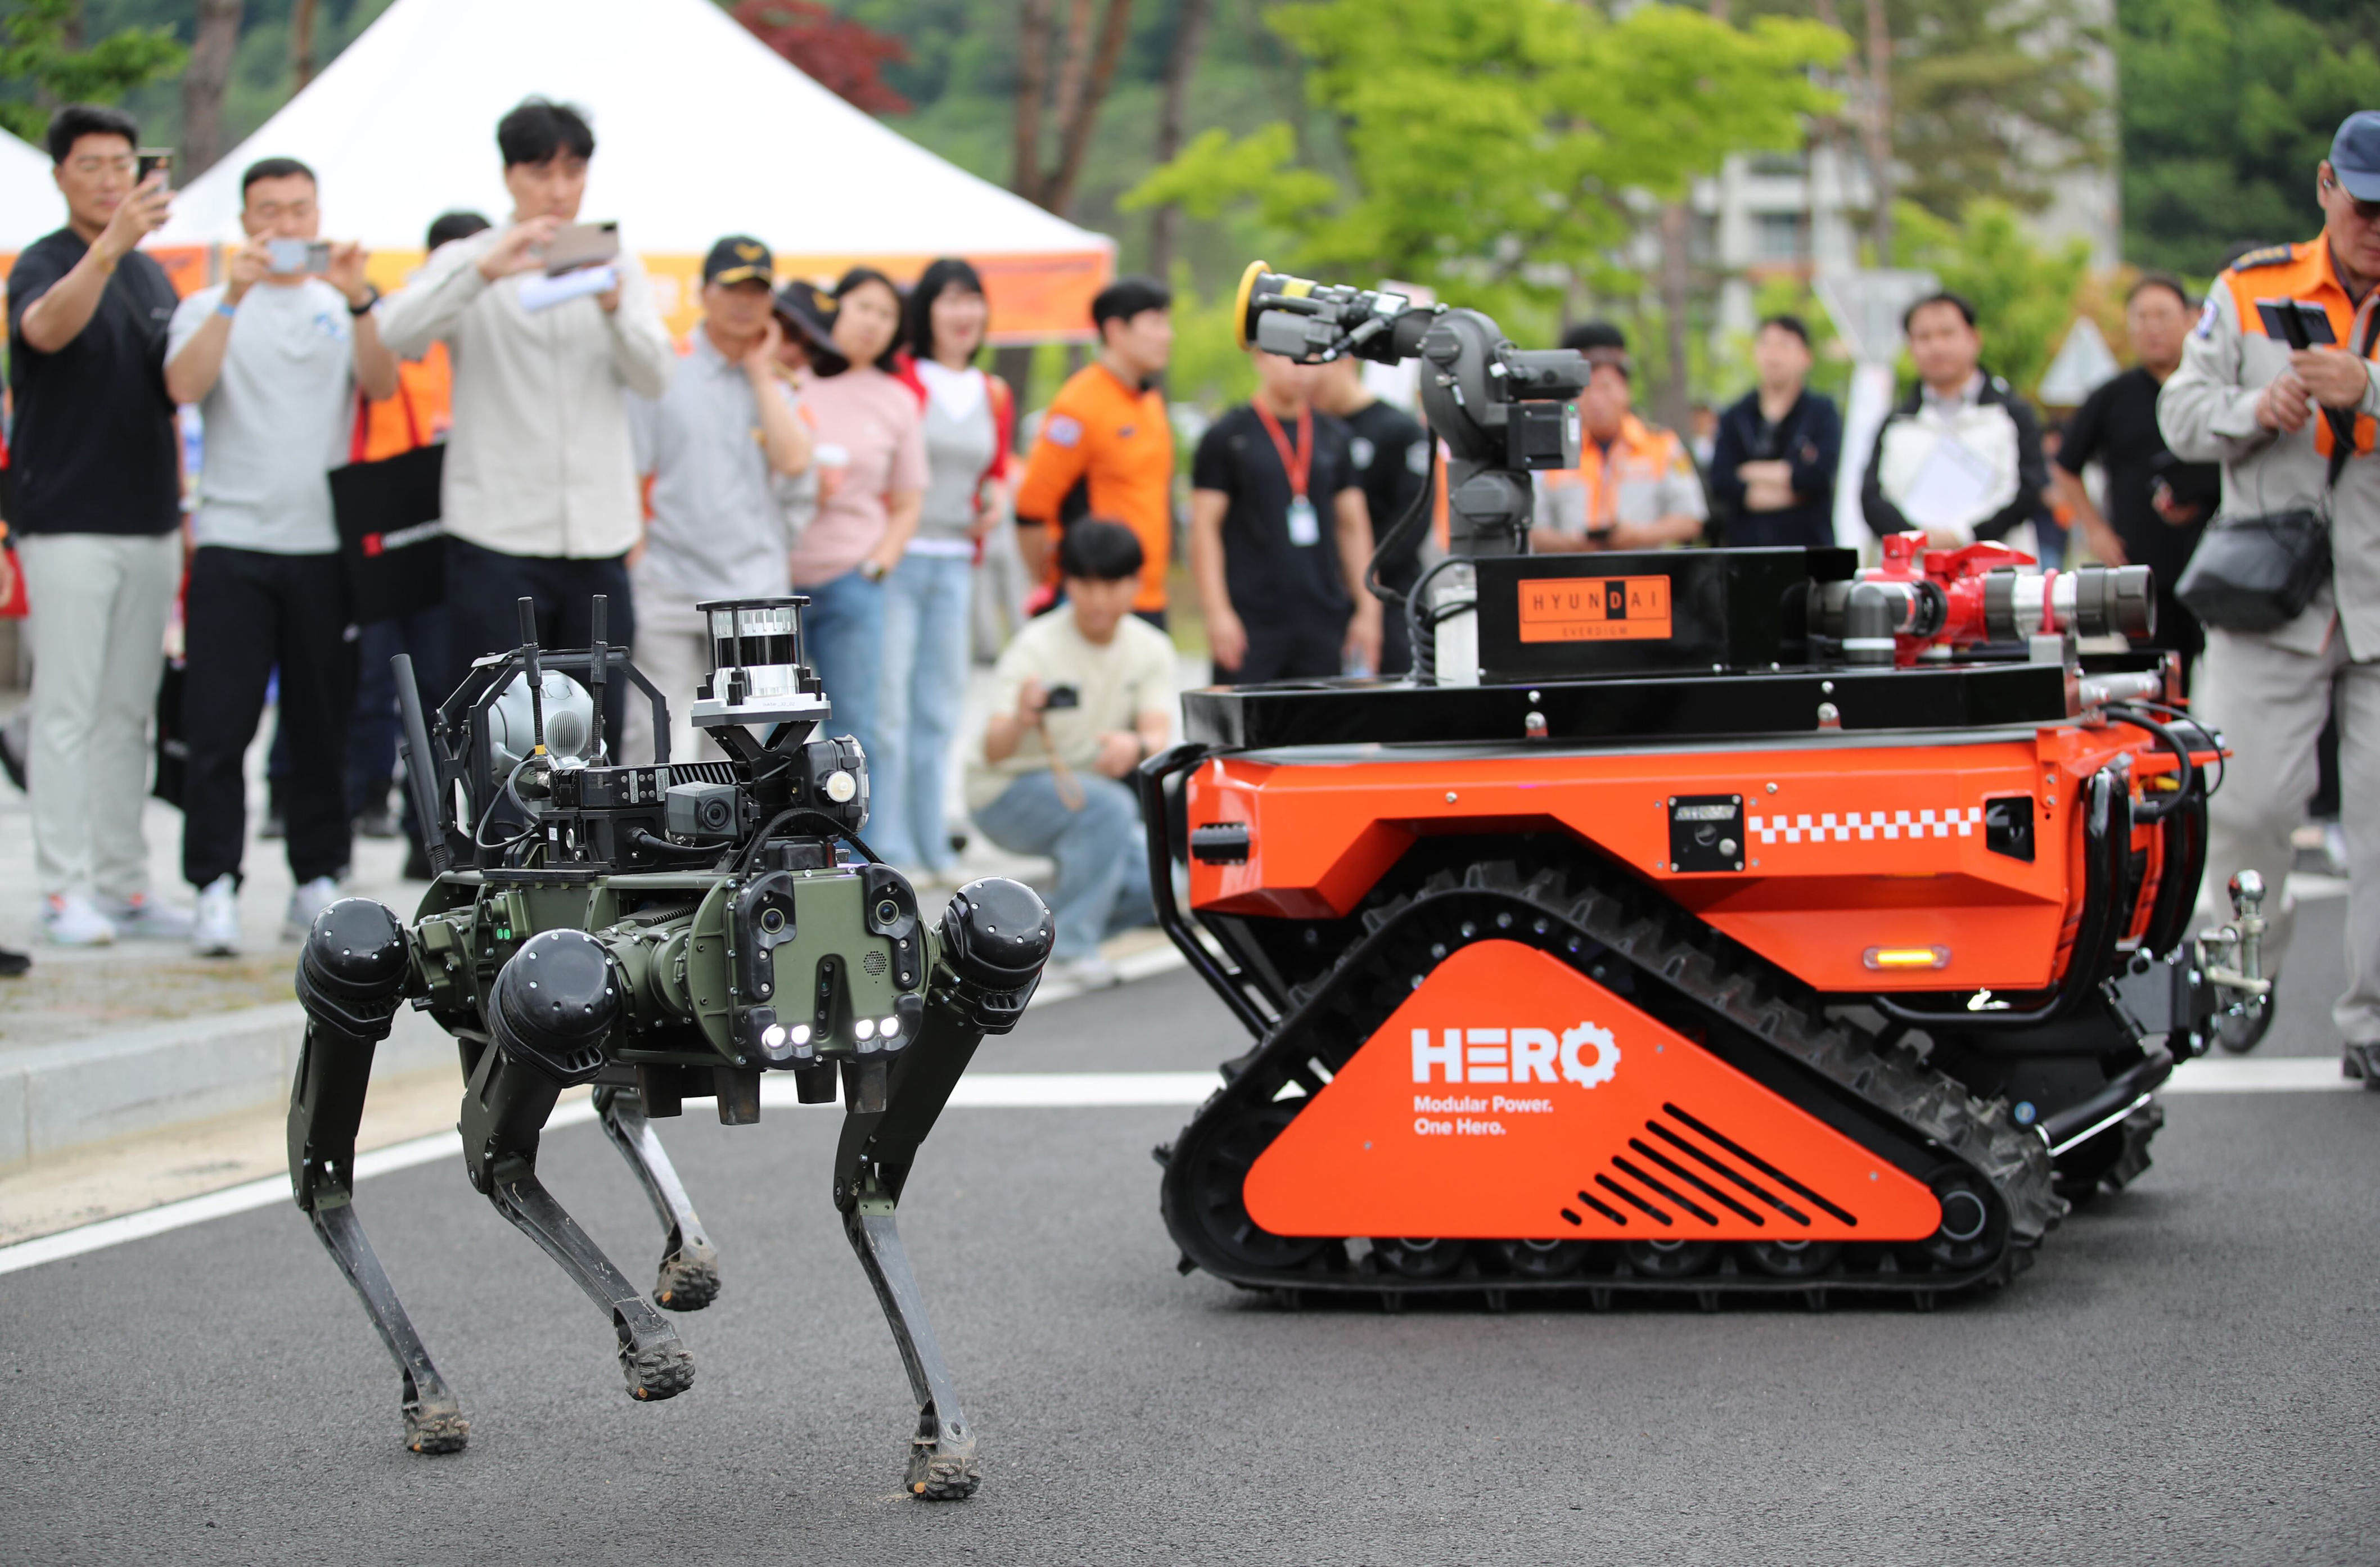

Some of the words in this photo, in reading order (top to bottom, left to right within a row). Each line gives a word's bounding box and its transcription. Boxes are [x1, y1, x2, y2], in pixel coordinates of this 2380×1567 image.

[1533, 591, 1656, 610] HYUNDAI
[1411, 1021, 1621, 1089] HERO
[1413, 1095, 1488, 1113] Modular
[1492, 1095, 1553, 1113] Power.
[1413, 1118, 1453, 1135] One
[1456, 1118, 1506, 1135] Hero.
